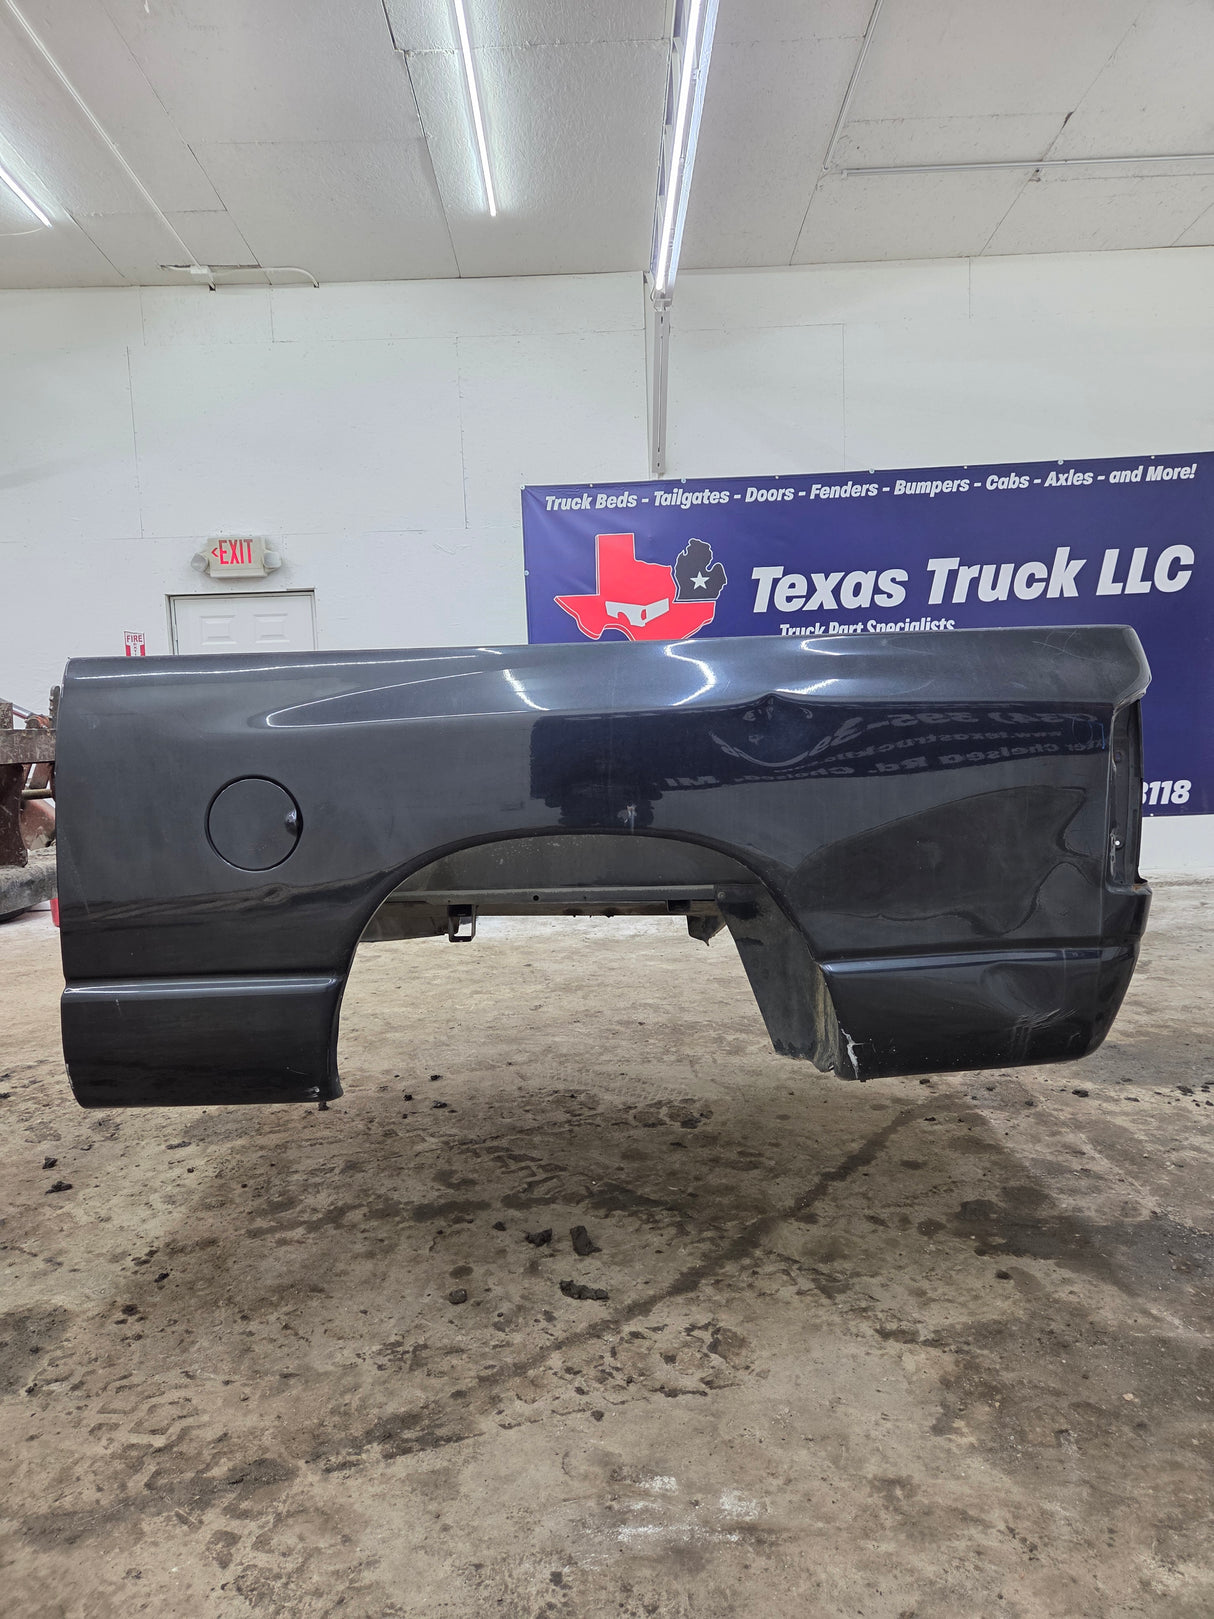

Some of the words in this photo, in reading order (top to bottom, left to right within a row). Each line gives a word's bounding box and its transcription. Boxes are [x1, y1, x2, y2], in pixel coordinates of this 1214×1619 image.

[546, 493, 592, 511] Truck
[595, 492, 637, 509] Beds
[654, 489, 730, 509] Tailgates
[745, 486, 795, 503] Doors
[810, 482, 878, 500] Fenders
[894, 473, 970, 498] Bumpers
[985, 473, 1030, 491] Cabs
[1044, 469, 1093, 488] Axles
[1109, 465, 1143, 483] and
[1146, 463, 1197, 482] More!
[218, 539, 253, 565] EXIT
[751, 565, 909, 614] Texas
[926, 546, 1087, 606] Truck
[1095, 543, 1195, 596] LLC
[126, 635, 142, 643] FIRE
[780, 622, 825, 636] Truck
